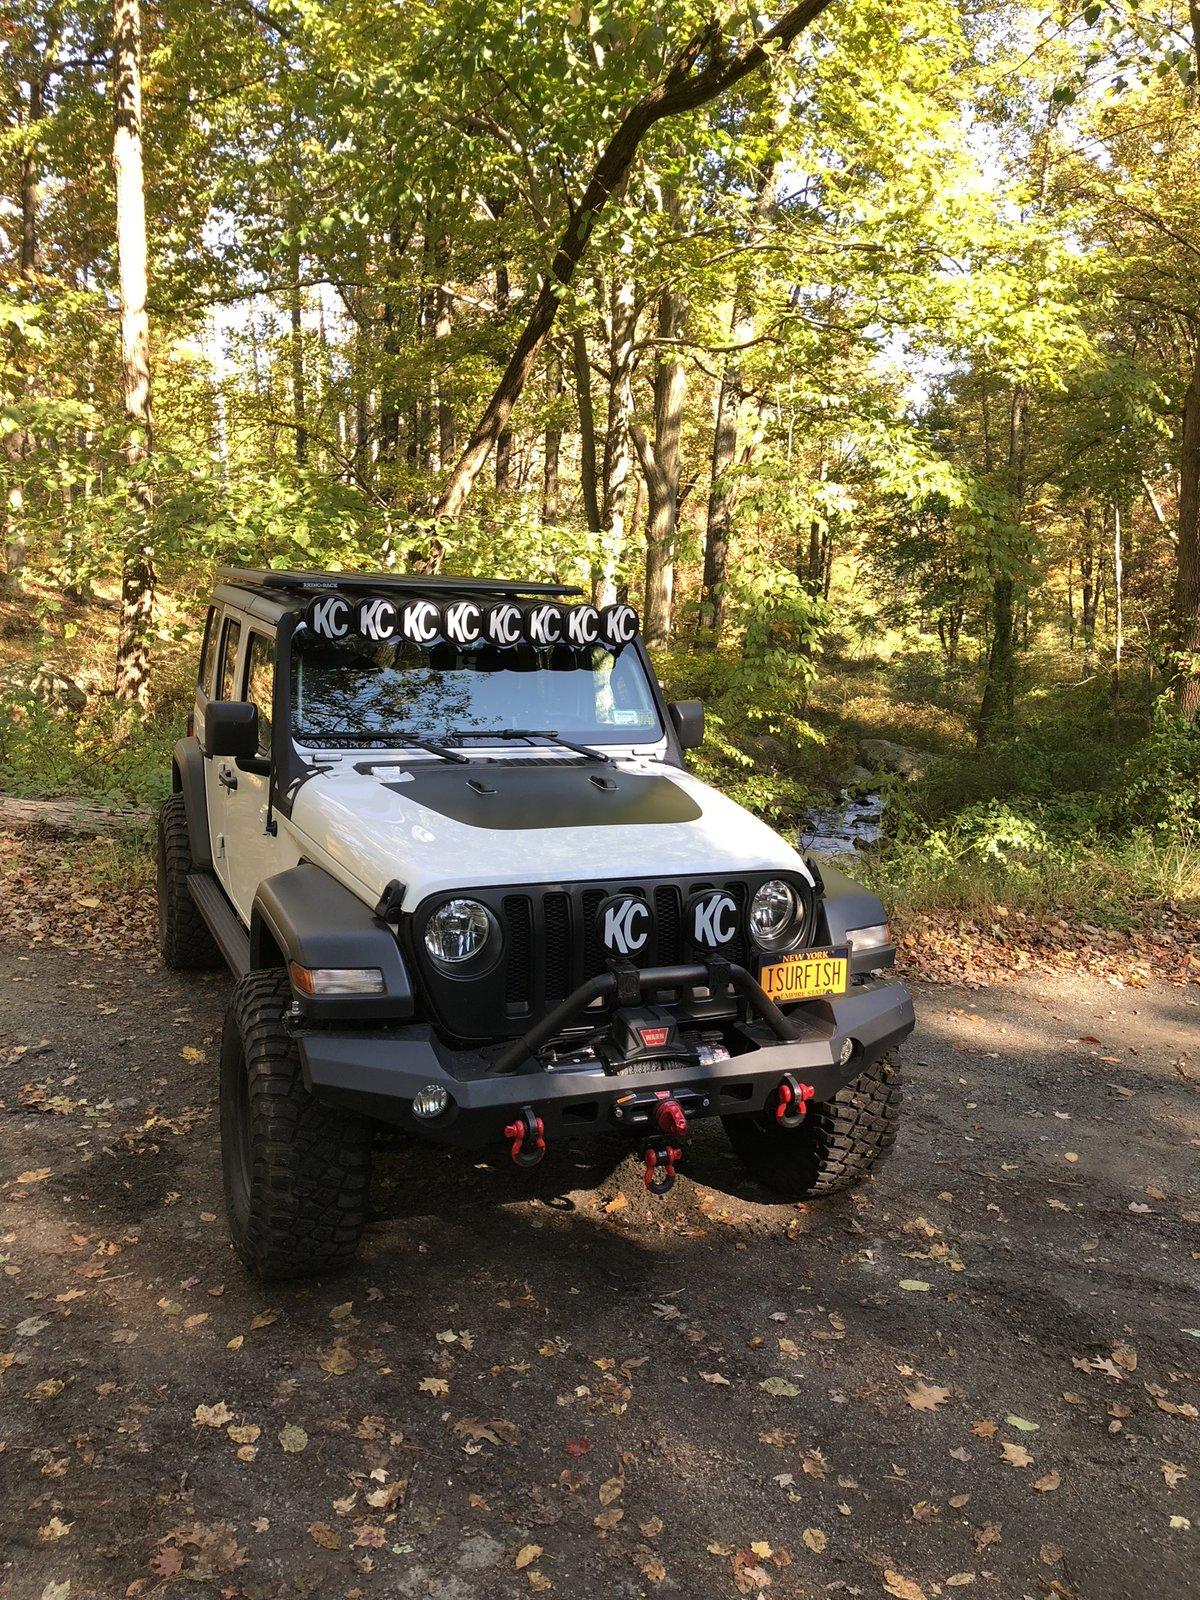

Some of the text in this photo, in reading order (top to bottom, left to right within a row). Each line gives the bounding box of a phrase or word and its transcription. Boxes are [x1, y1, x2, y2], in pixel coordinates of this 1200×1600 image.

[314, 598, 348, 638] KC
[360, 600, 394, 640] KC
[403, 601, 438, 642] KC
[447, 602, 480, 642] KC
[489, 605, 521, 644] KC
[530, 605, 561, 644] KC
[568, 606, 598, 644] KC
[606, 605, 636, 643] KC
[604, 900, 649, 954] KC
[694, 894, 737, 947] KC
[782, 950, 829, 963] NEW YORK
[767, 962, 841, 993] ISURFISH
[780, 991, 805, 999] EMPIRE
[644, 1033, 665, 1041] WARN
